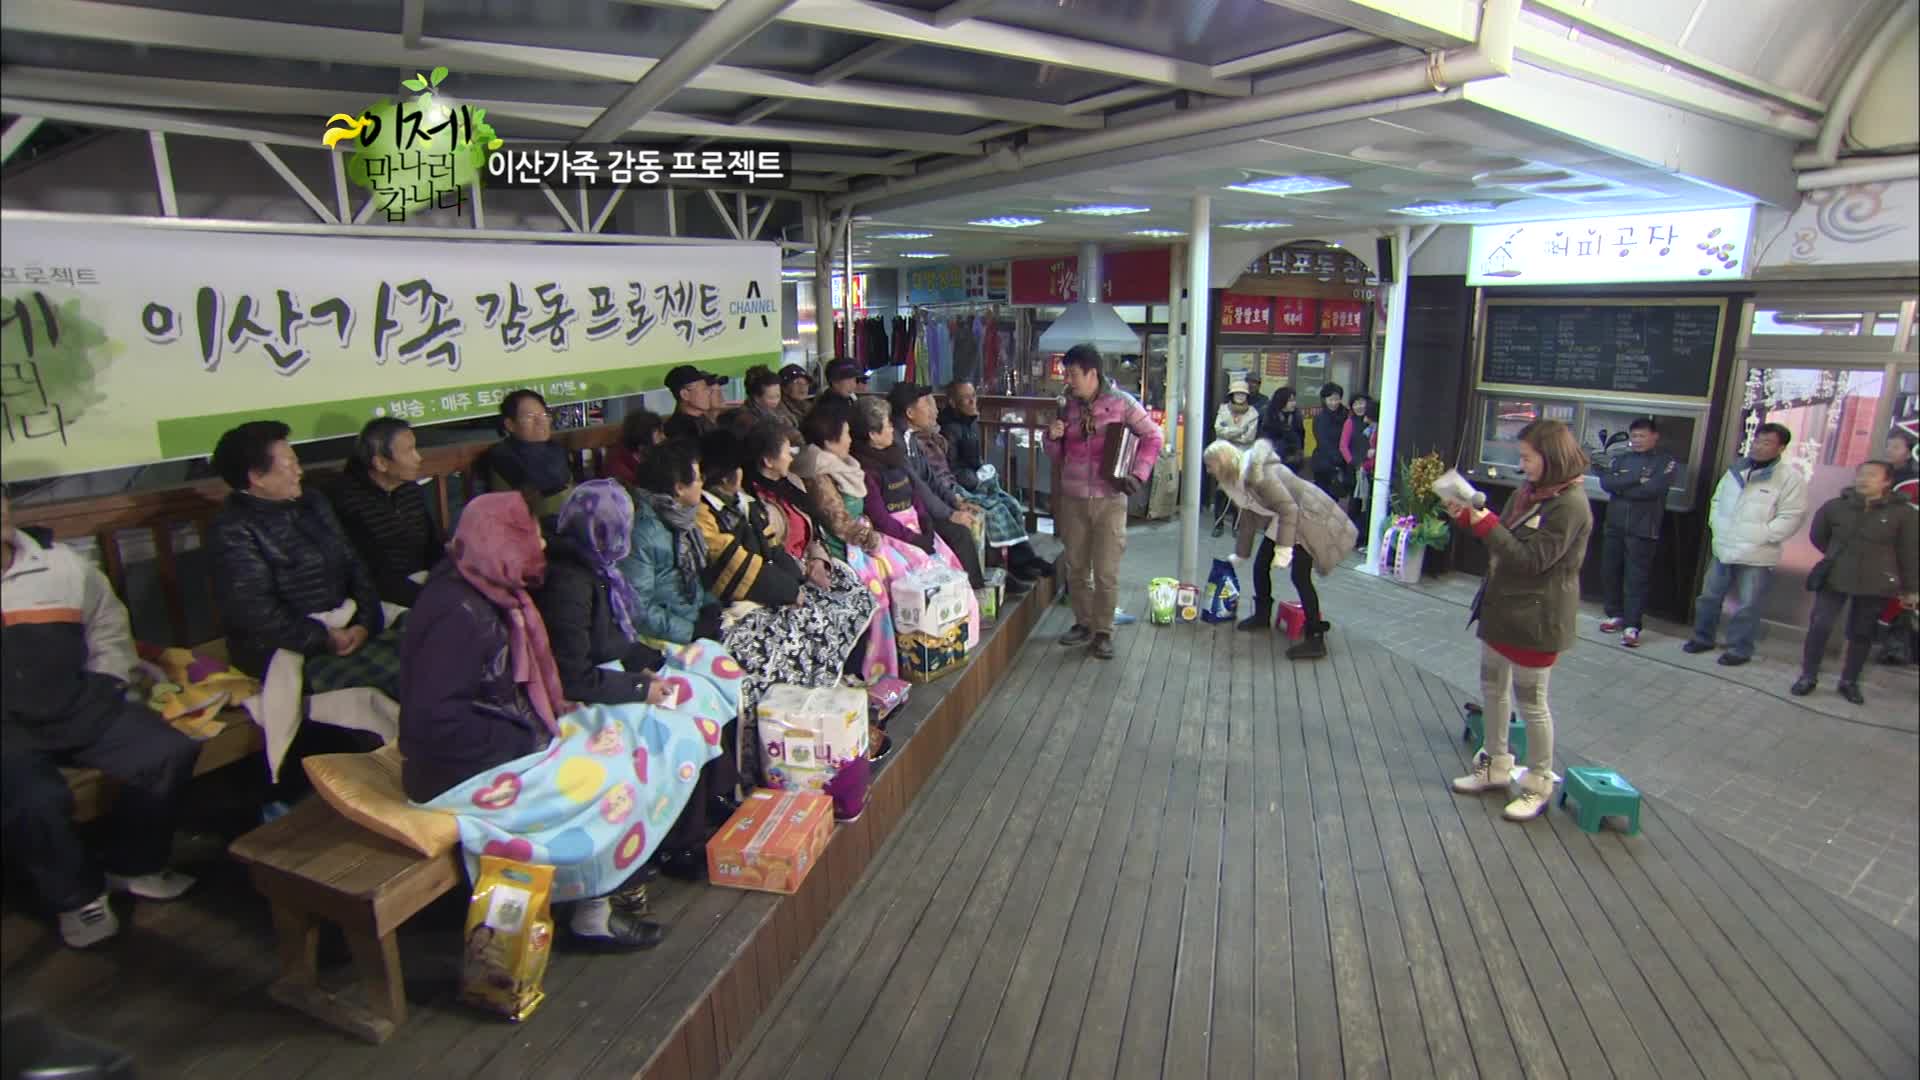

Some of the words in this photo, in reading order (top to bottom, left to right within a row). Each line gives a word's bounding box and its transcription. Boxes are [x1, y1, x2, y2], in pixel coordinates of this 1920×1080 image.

[729, 299, 778, 316] CHANNEL
[142, 279, 464, 371] 이산가족
[475, 281, 577, 348] 감동
[587, 280, 724, 342] 프로젝트
[389, 399, 425, 418] 방송
[441, 392, 473, 412] 매주
